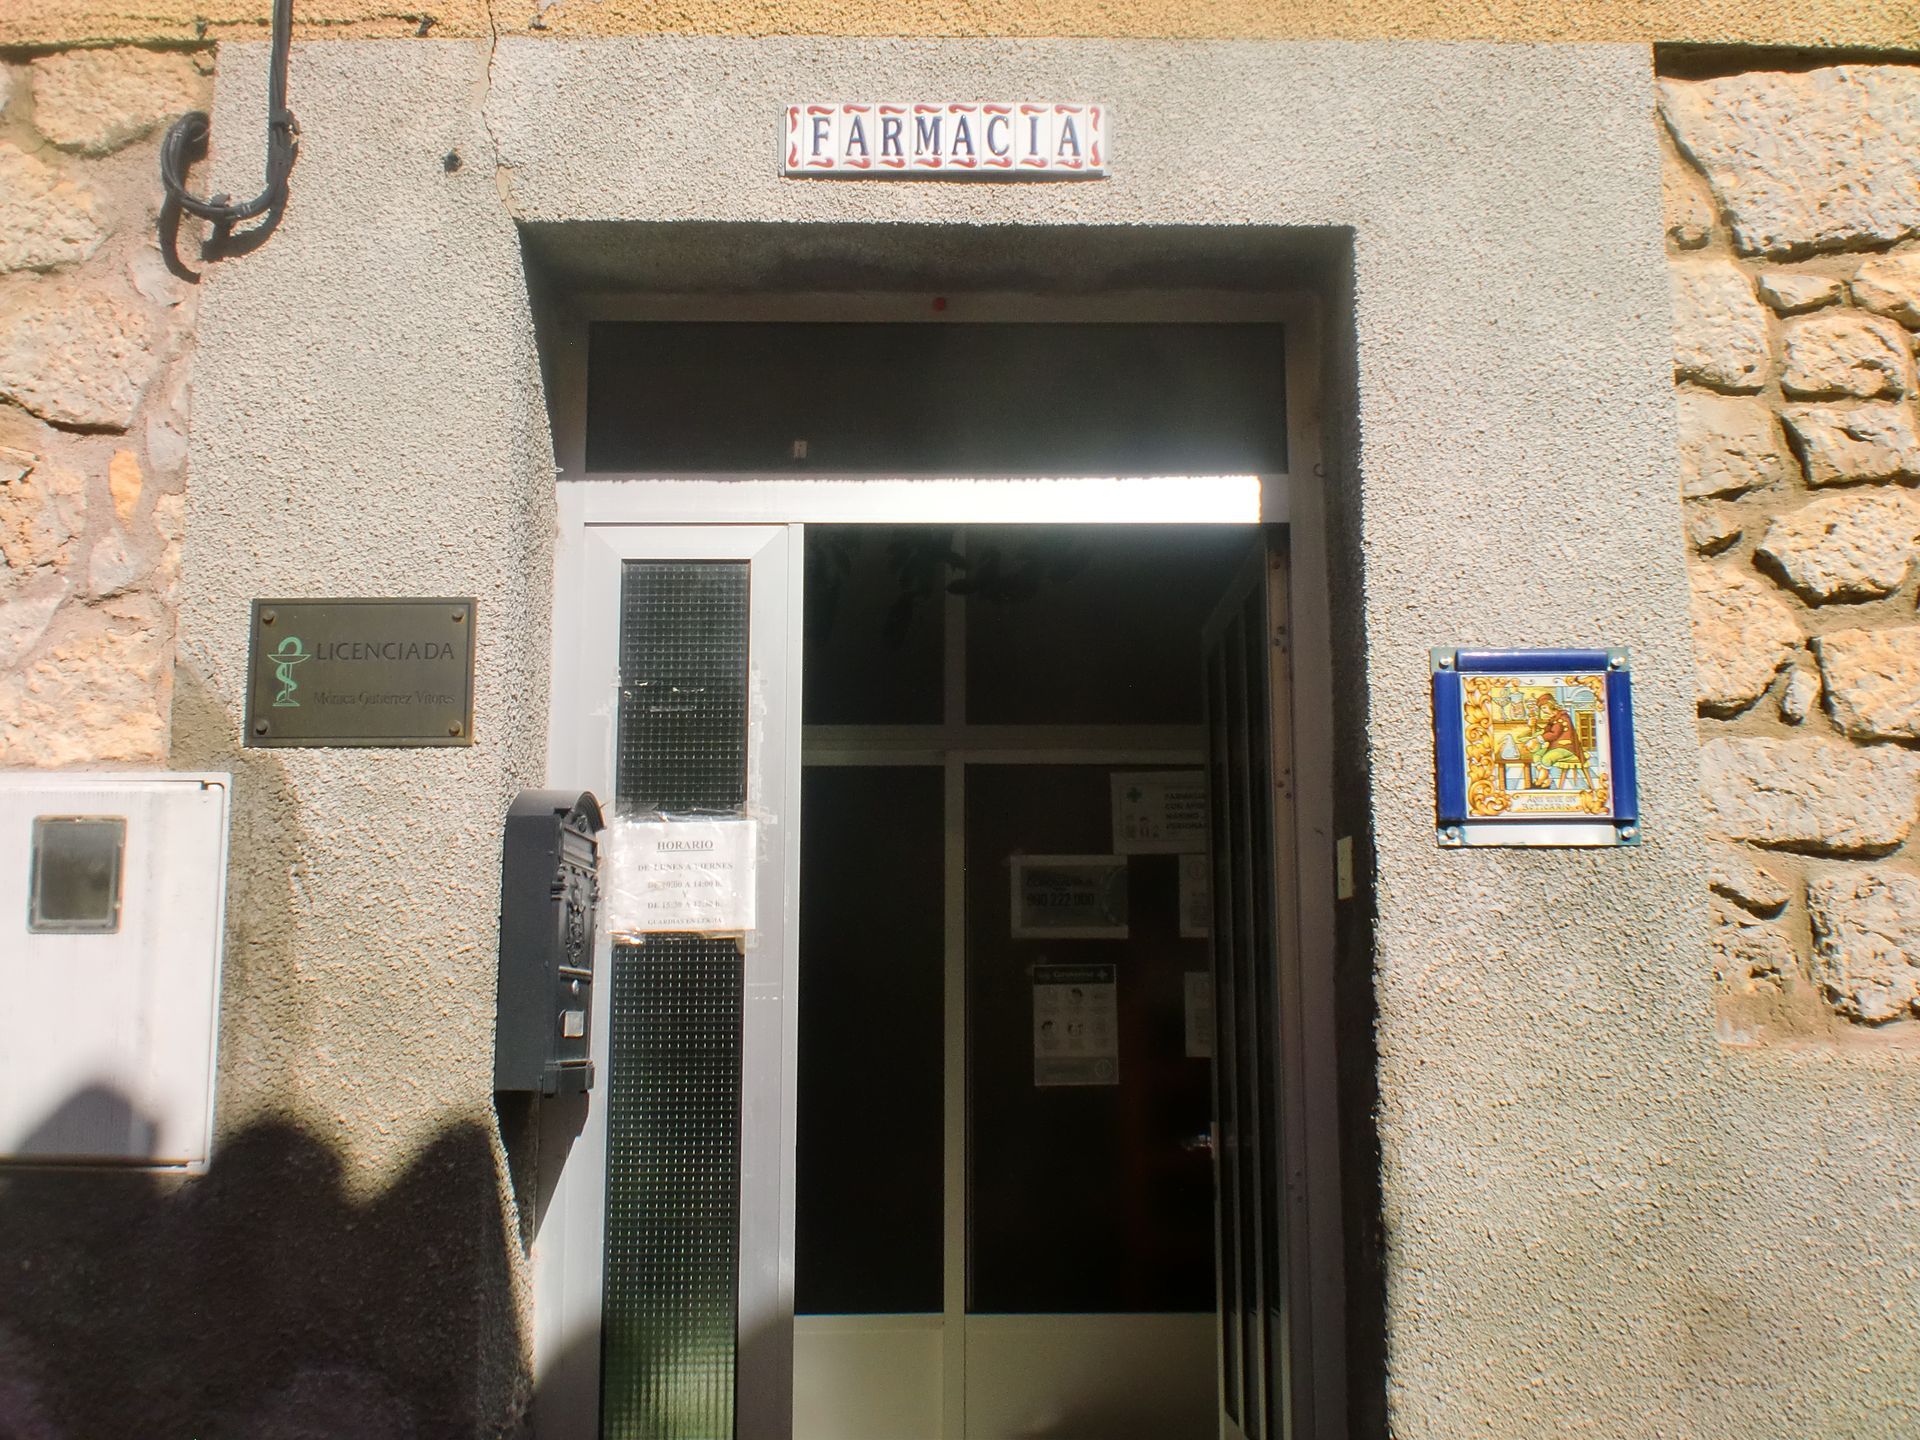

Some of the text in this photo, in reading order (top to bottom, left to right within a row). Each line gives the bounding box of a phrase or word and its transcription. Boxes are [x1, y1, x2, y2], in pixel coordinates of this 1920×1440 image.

[811, 114, 1084, 157] FARMACIA
[316, 642, 456, 661] LICENCIADA
[657, 839, 714, 850] HORARIO
